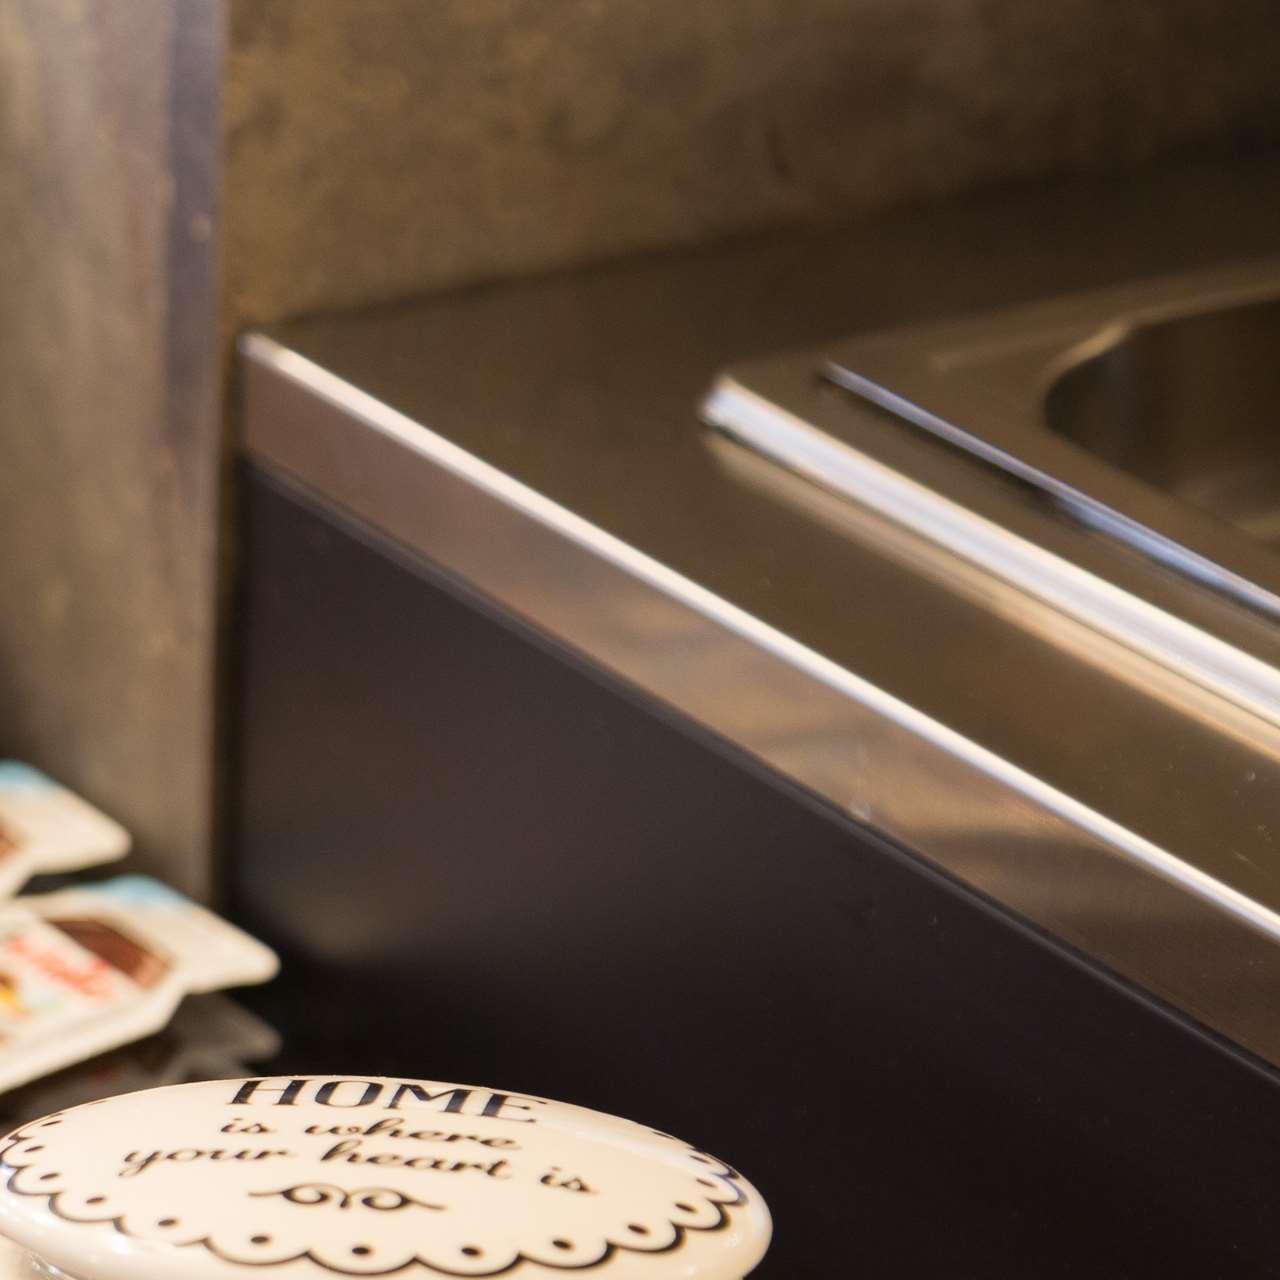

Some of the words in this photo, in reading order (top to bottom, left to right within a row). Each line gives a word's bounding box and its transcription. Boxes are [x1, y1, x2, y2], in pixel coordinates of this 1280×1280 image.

[226, 1079, 547, 1124] HOME
[220, 1117, 277, 1134] is
[304, 1117, 522, 1150] where
[118, 1150, 297, 1178] your
[319, 1139, 513, 1180] heart
[540, 1166, 602, 1195] is
